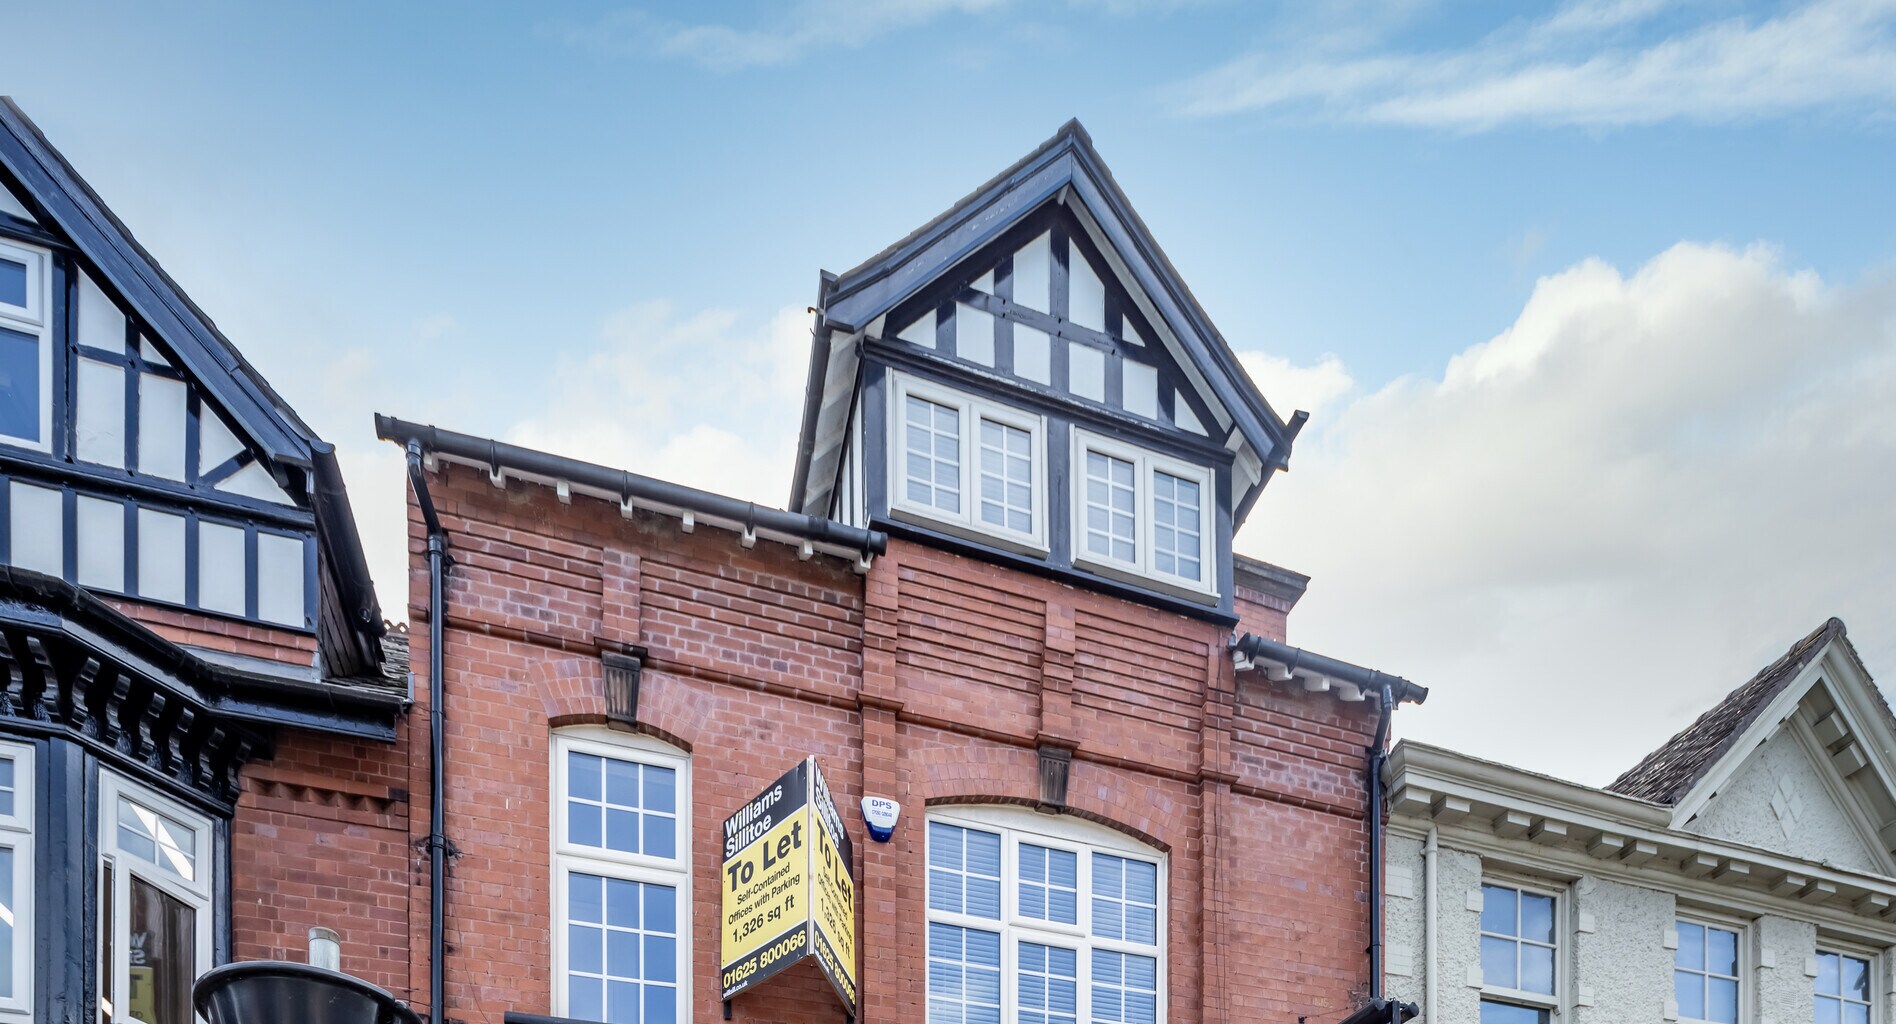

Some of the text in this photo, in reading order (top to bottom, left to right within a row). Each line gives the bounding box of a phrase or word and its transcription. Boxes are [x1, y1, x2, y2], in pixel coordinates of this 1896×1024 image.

[725, 784, 783, 838] Williams
[871, 799, 892, 810] DPS
[725, 813, 772, 858] Sillitoe
[728, 820, 802, 892] To Let
[737, 862, 790, 905] Self-Contained
[817, 818, 852, 913] To Let
[728, 873, 800, 925] Offices with Parking
[732, 895, 795, 943] 1,326 sq ft
[723, 956, 757, 989] 01625
[759, 929, 806, 968] 800066
